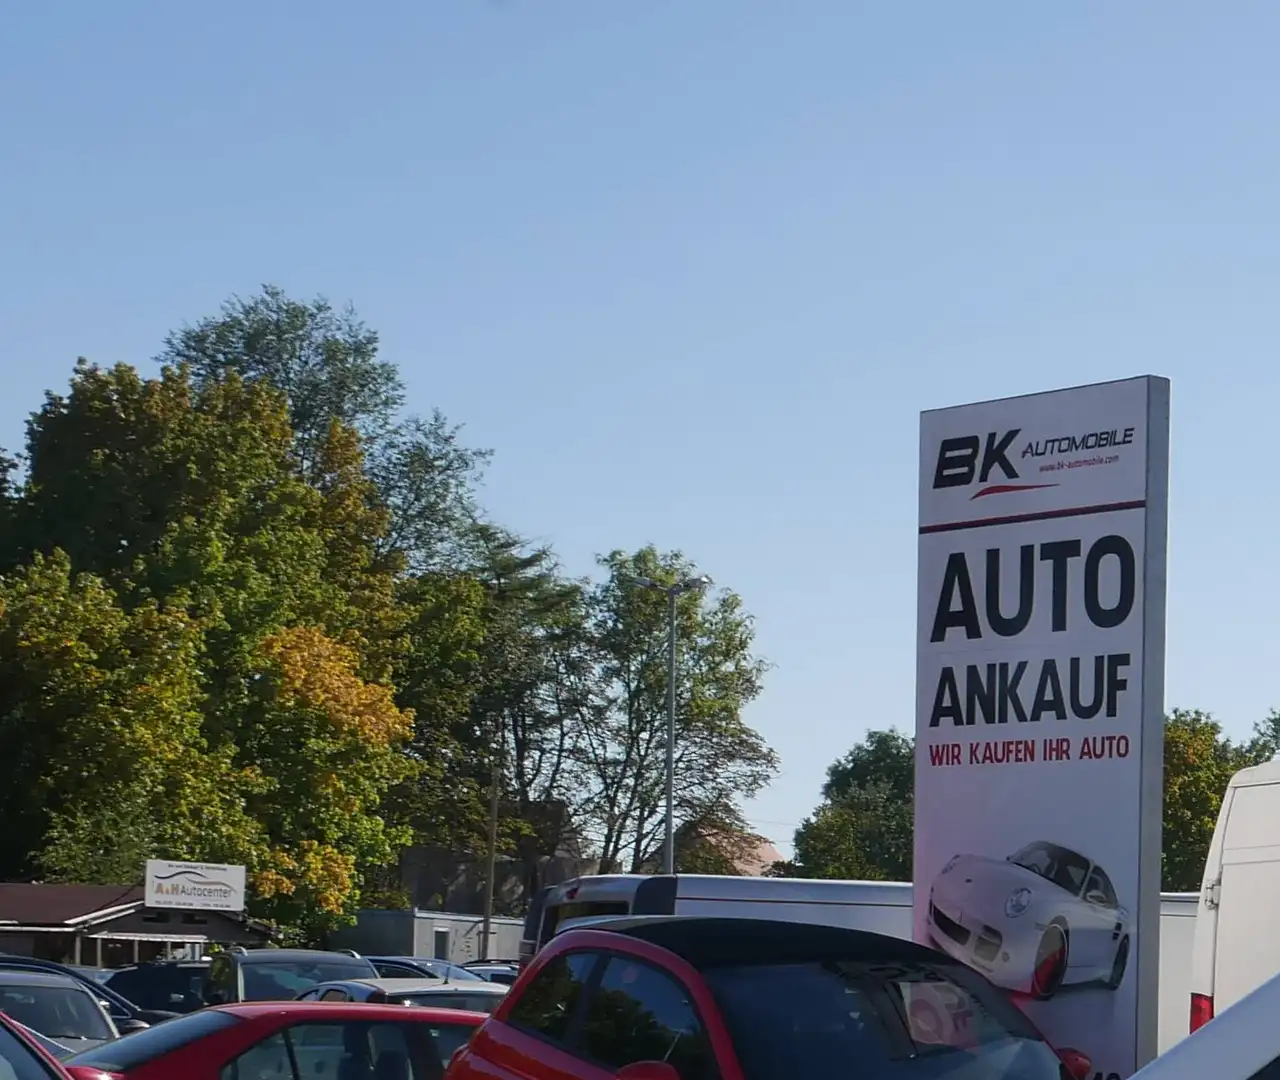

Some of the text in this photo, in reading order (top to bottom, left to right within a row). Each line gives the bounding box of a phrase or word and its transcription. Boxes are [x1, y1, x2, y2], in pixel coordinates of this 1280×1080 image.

[933, 427, 1135, 489] BK AUTOMOBILE
[930, 535, 1136, 643] AUTO
[929, 653, 1131, 728] ANKAUF
[929, 735, 1130, 767] WIR KAUFEN IHR AUTO
